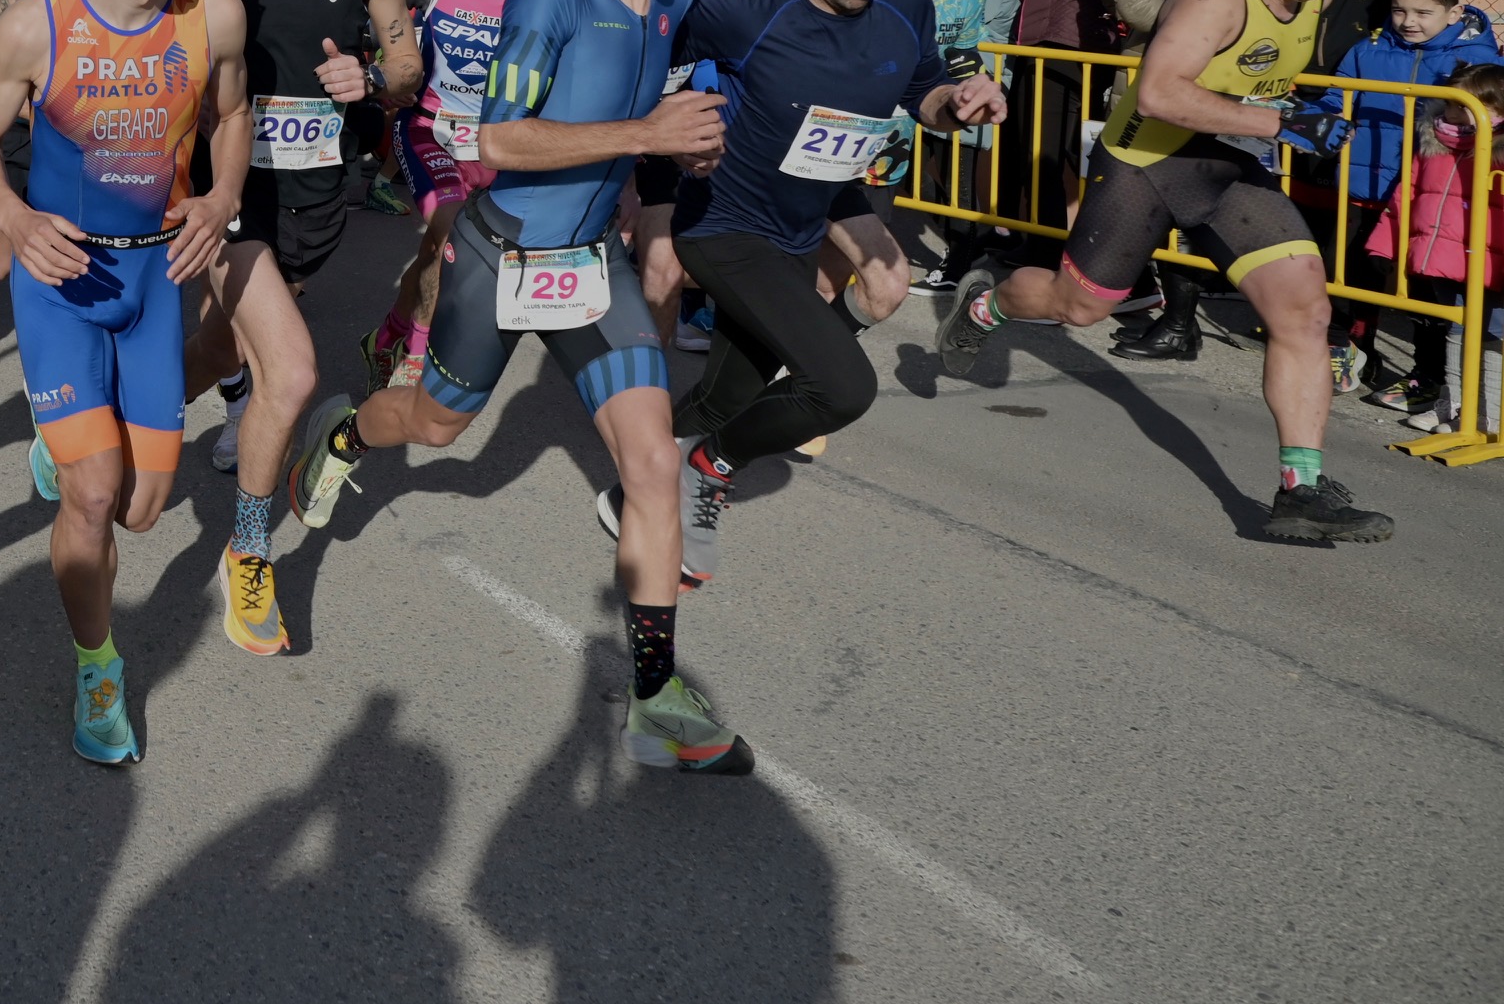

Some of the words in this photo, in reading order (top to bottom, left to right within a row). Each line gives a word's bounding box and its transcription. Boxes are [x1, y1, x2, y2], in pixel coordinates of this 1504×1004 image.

[77, 55, 160, 80] PRAT
[1245, 53, 1278, 63] VEC
[76, 79, 158, 97] TRIATLÓ
[94, 107, 168, 140] GERARD
[256, 117, 322, 143] 206
[801, 128, 868, 158] 211
[531, 272, 578, 299] 29
